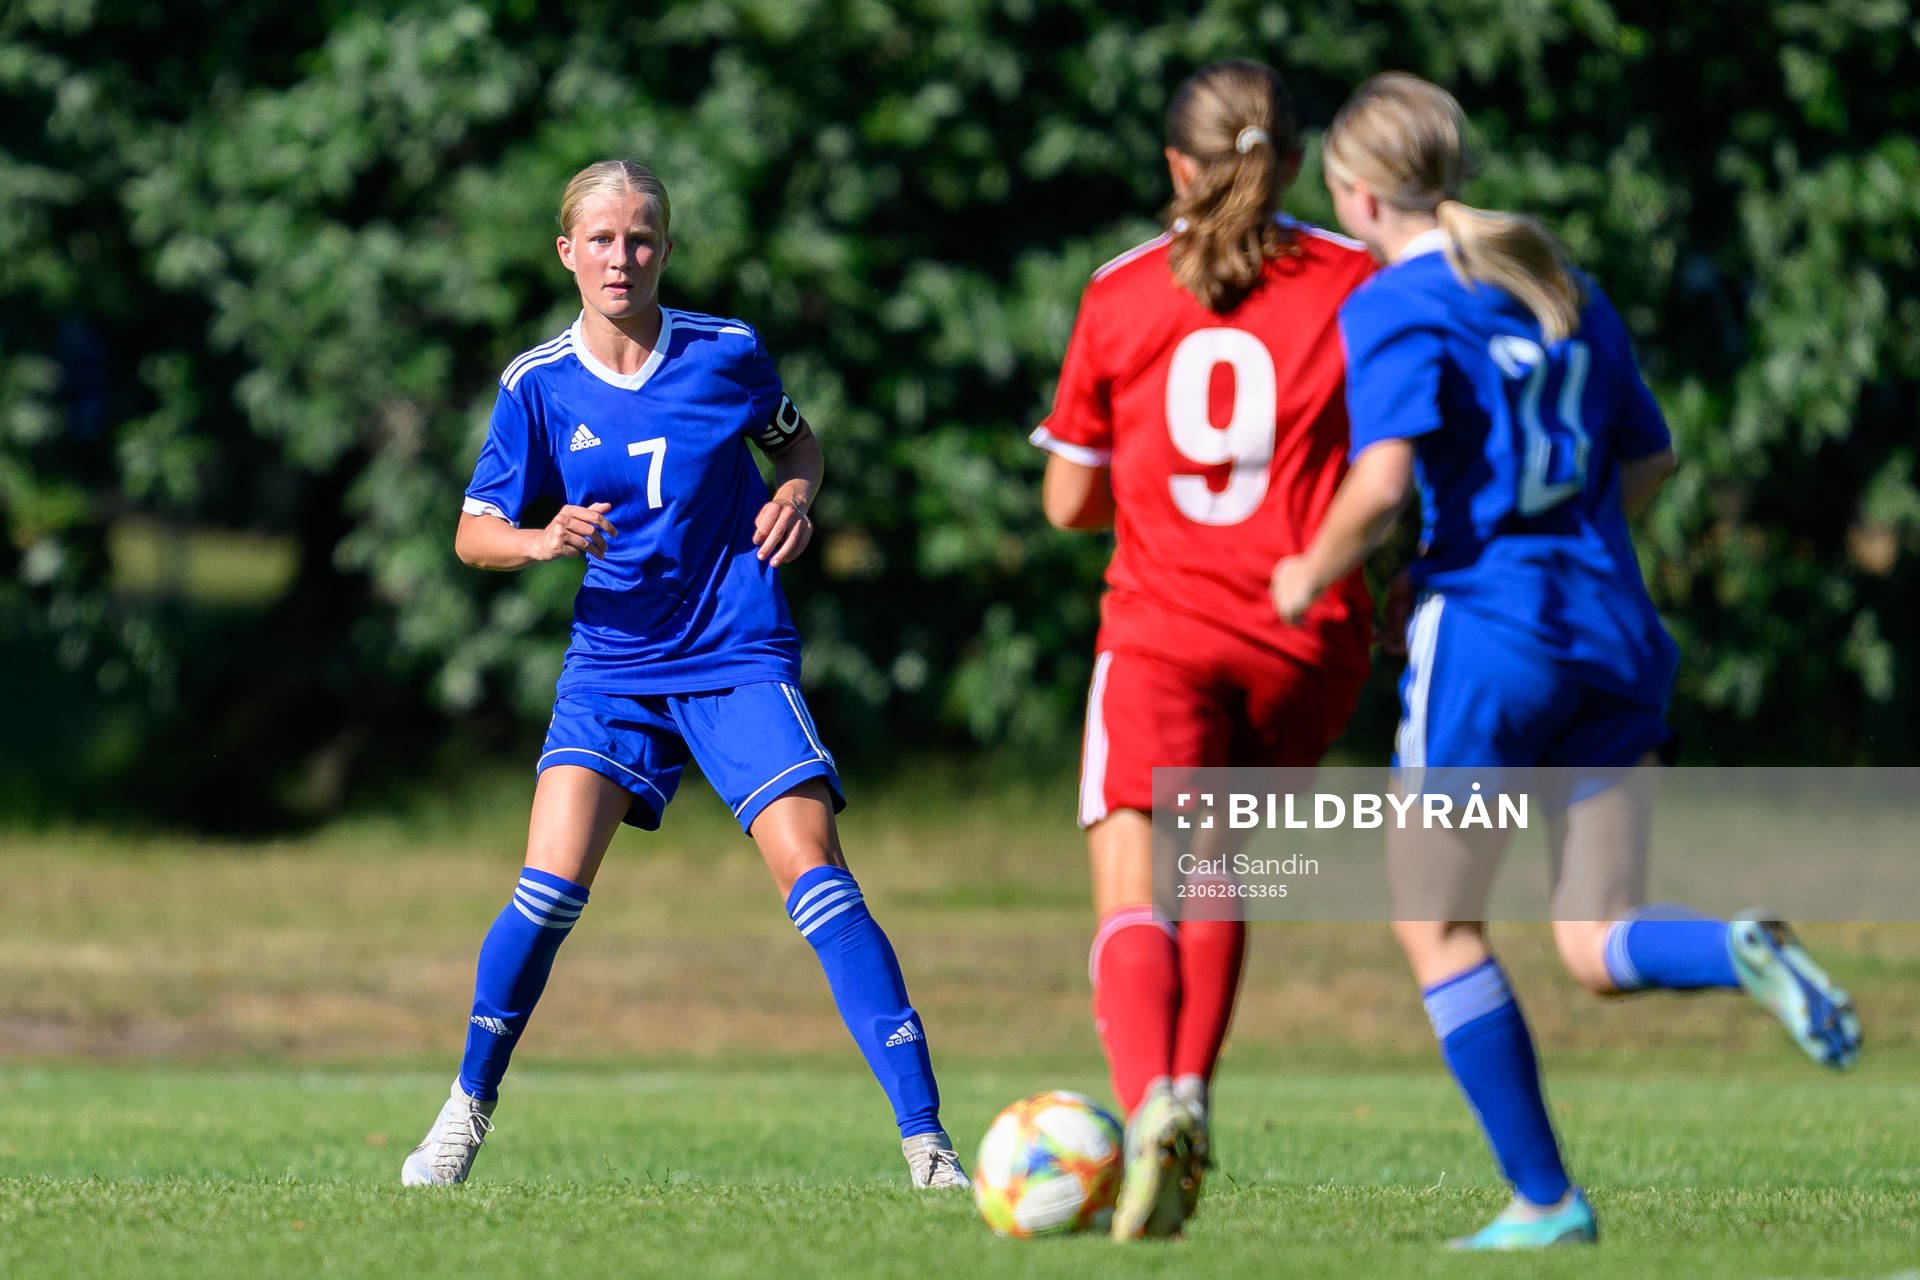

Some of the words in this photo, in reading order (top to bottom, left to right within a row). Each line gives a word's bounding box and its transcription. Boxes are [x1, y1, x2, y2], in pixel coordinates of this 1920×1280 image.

[570, 437, 602, 452] adidas
[1165, 327, 1277, 526] 9
[626, 436, 667, 510] 7
